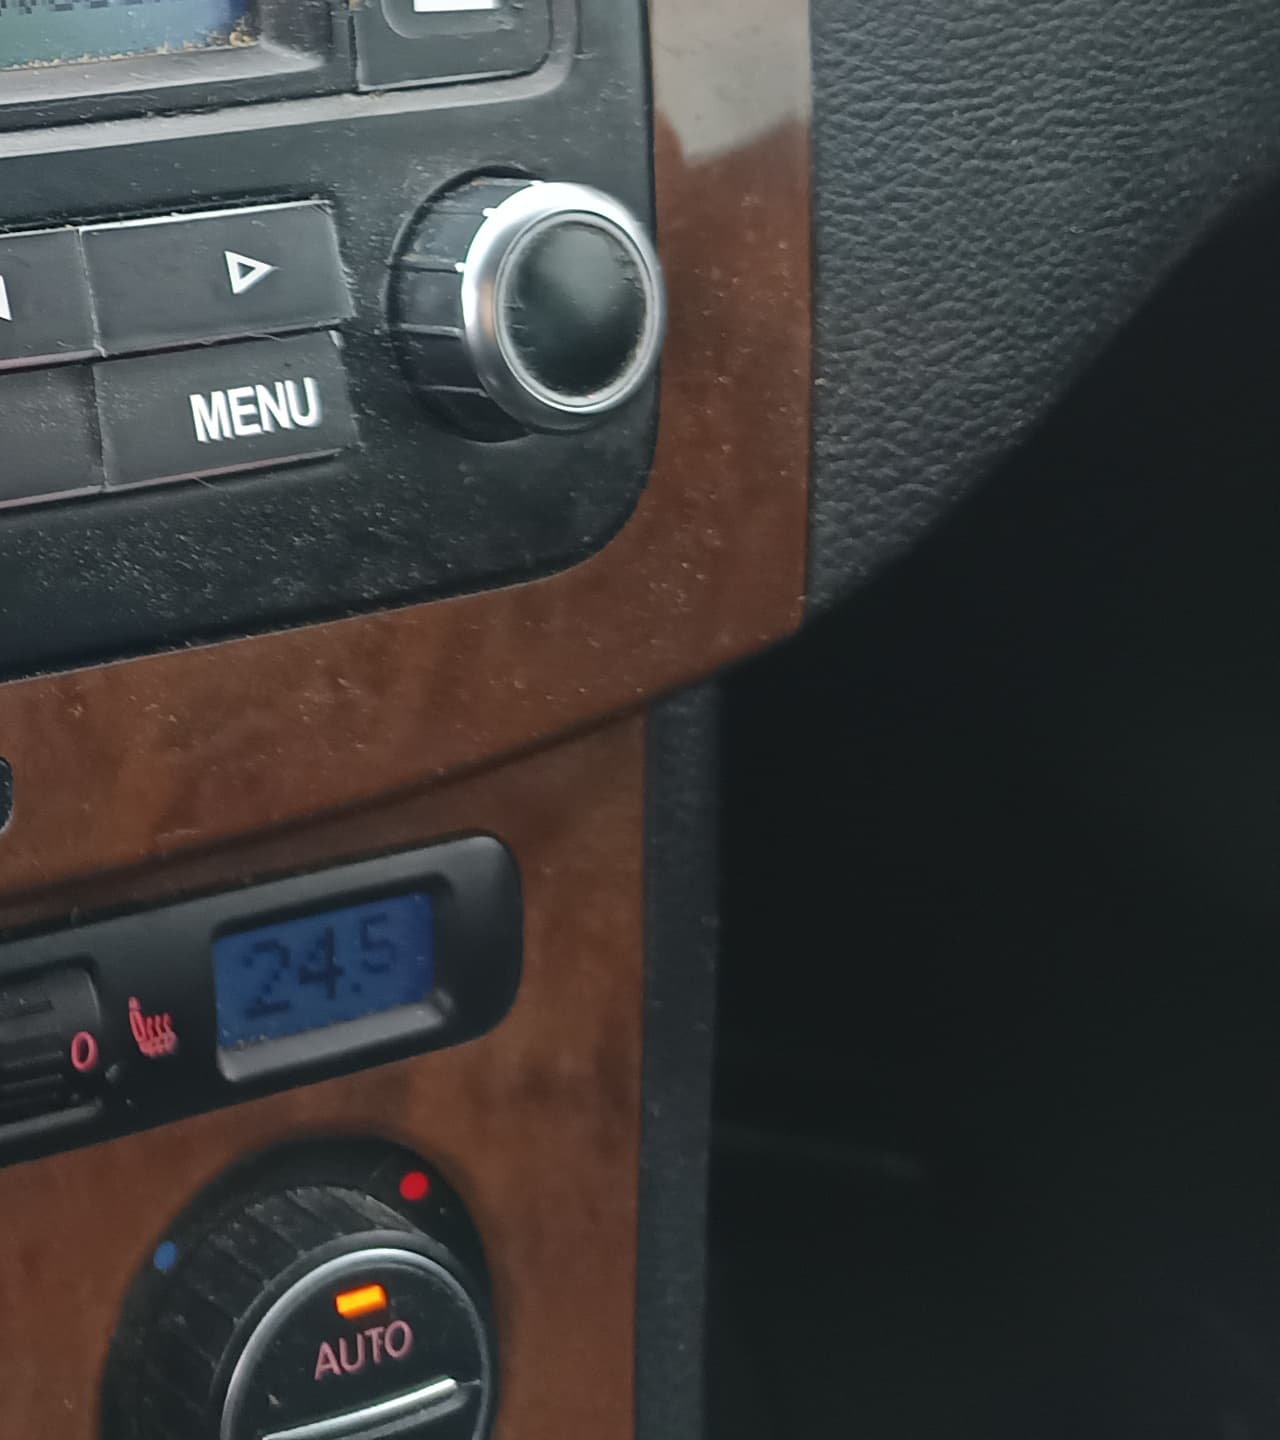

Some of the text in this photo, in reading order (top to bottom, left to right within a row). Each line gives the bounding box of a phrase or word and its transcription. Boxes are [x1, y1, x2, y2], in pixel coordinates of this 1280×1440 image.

[189, 376, 322, 444] MENU
[245, 912, 398, 1020] 24.5
[313, 1320, 415, 1381] AUTO
